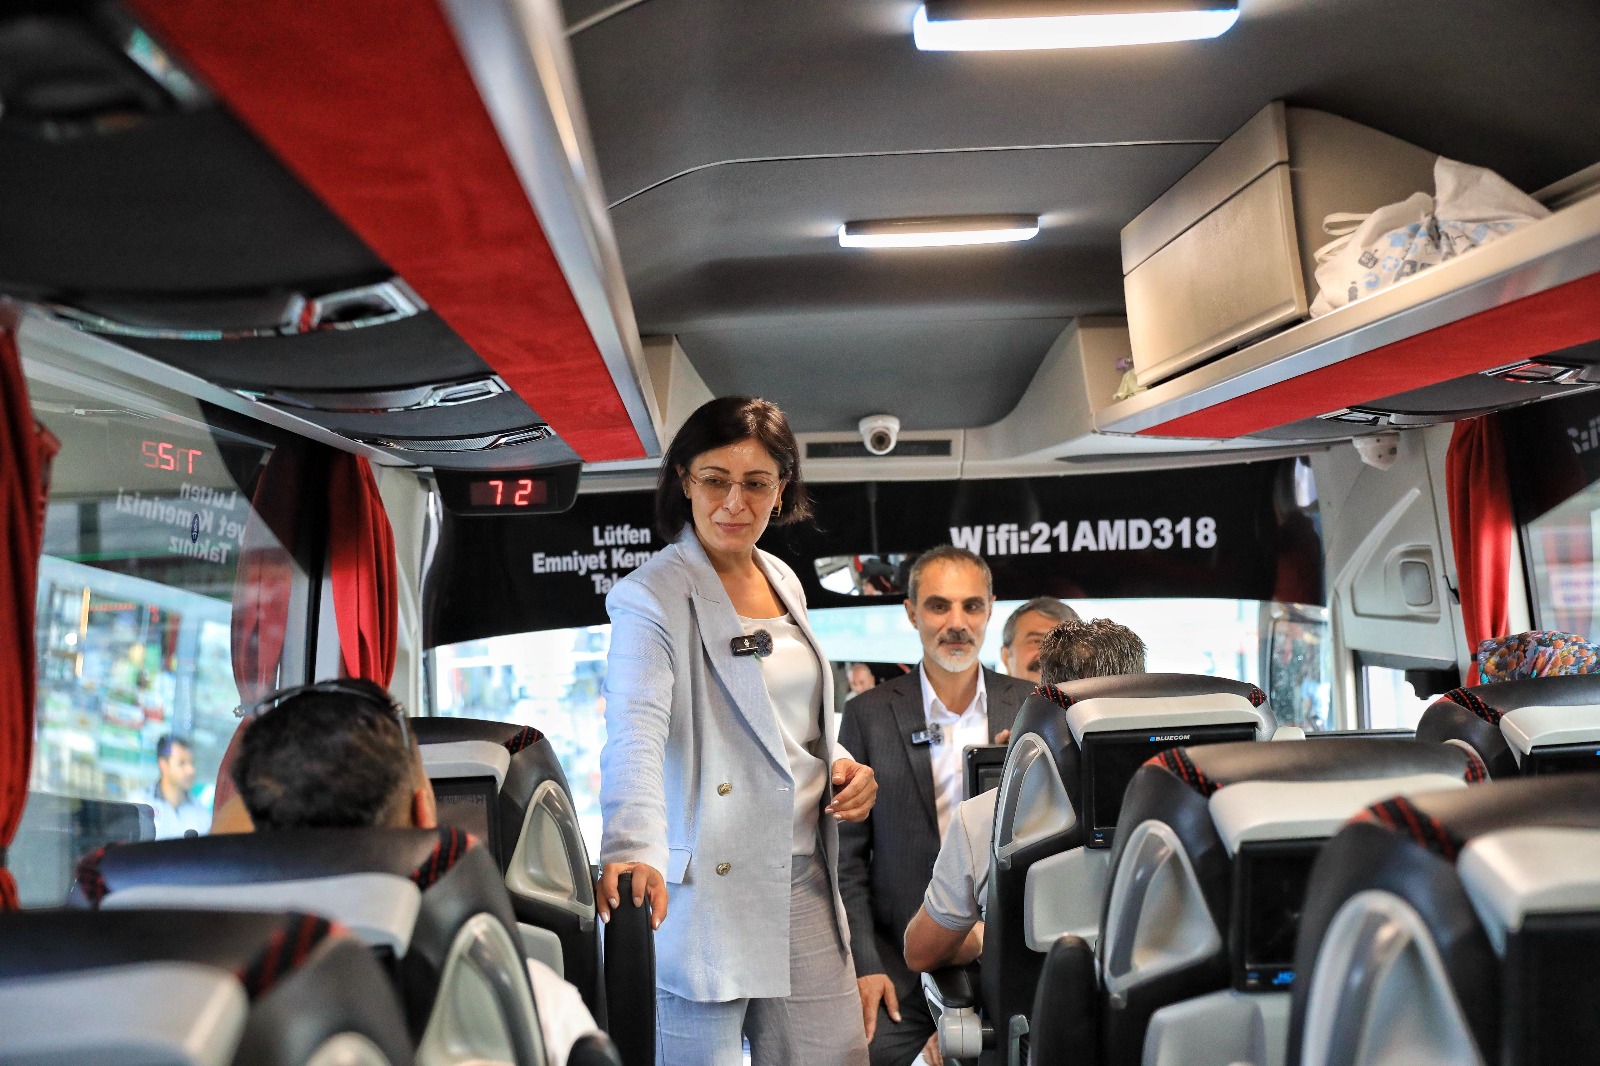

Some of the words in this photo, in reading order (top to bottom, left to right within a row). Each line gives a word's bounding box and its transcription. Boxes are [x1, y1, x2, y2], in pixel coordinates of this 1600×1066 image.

[592, 524, 652, 547] Lütfen
[950, 516, 1218, 556] Wifi:21AMD318
[532, 549, 608, 576] Emniyet
[1155, 734, 1190, 742] BLUECOM
